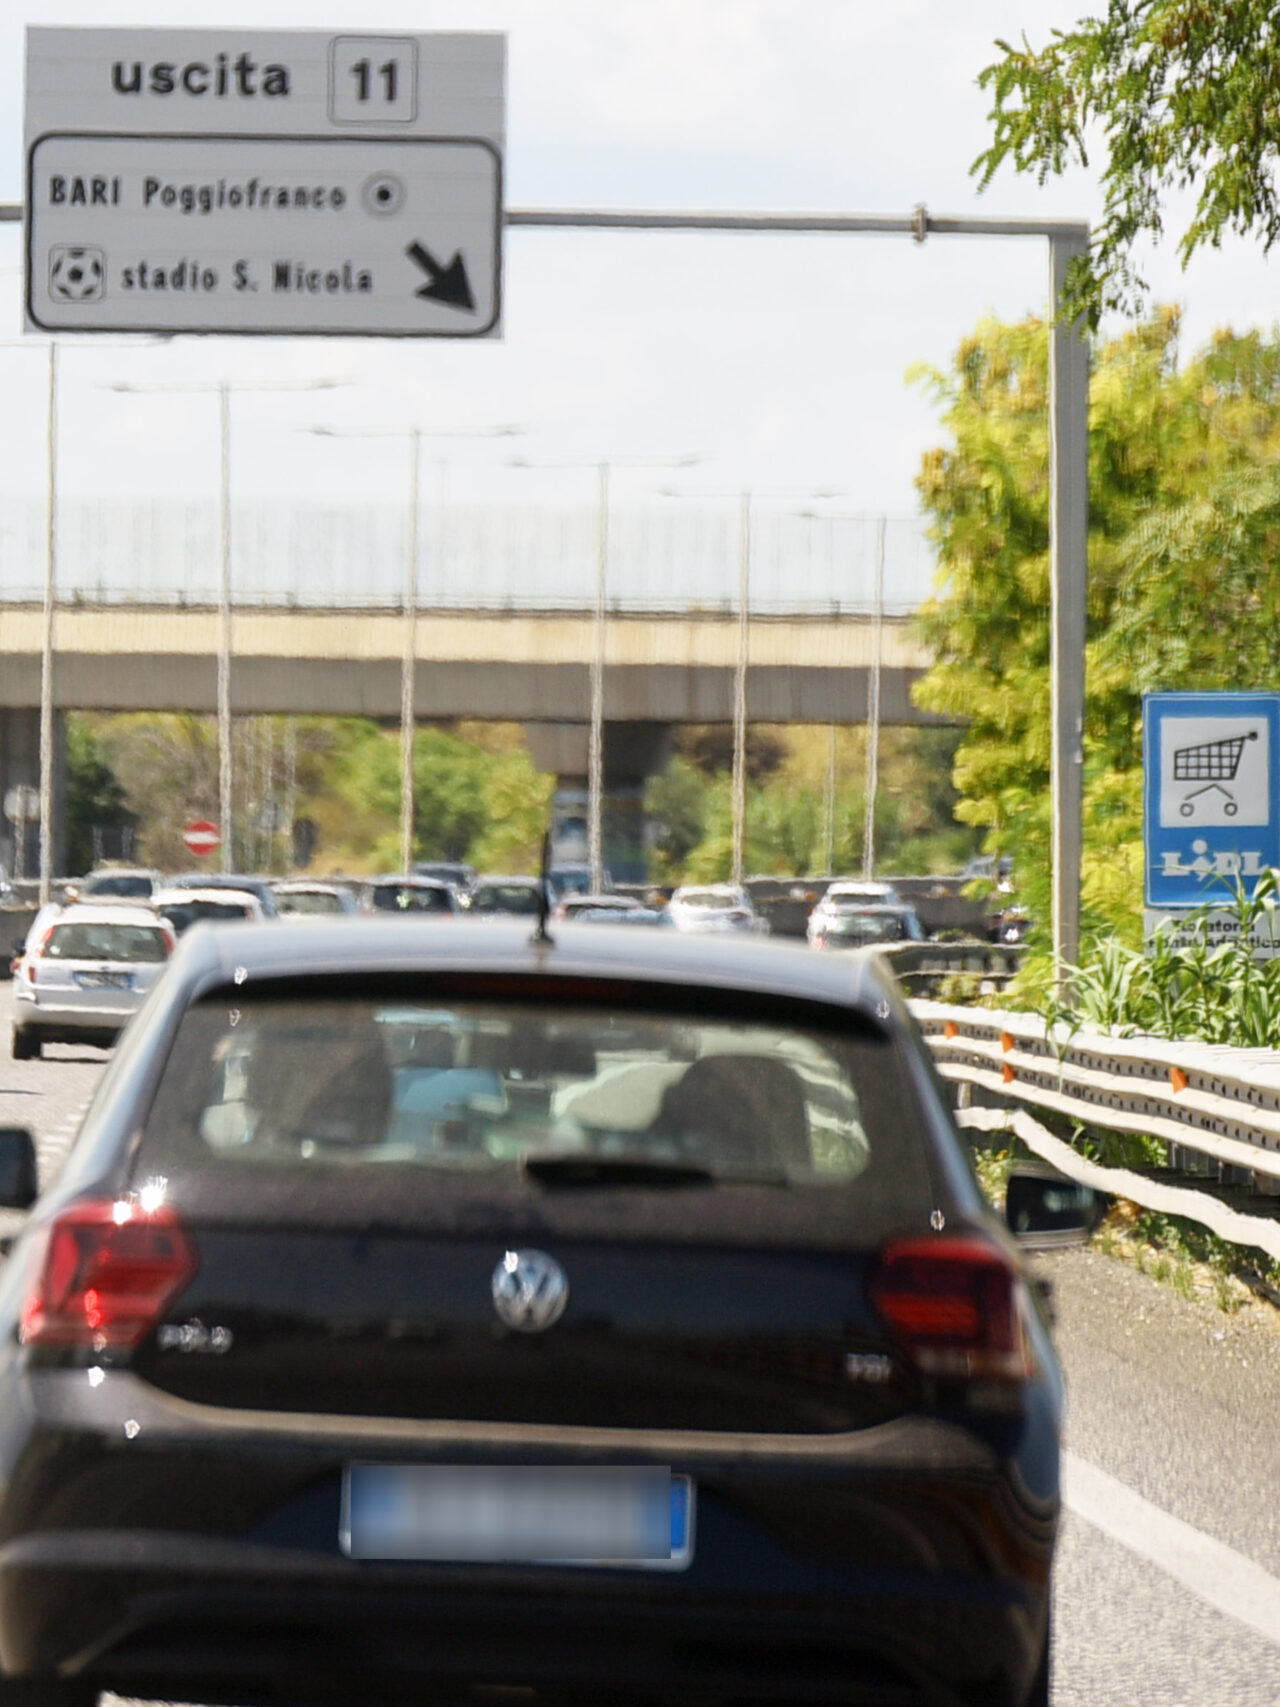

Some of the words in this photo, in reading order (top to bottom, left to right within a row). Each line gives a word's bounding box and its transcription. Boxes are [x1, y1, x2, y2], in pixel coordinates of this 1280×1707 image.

[111, 52, 291, 97] uscita
[351, 57, 400, 102] 11
[49, 175, 121, 207] BARI
[142, 176, 347, 214] Poggiofranco
[121, 256, 218, 291] stadio
[233, 259, 260, 292] S.
[272, 259, 374, 293] Nicola
